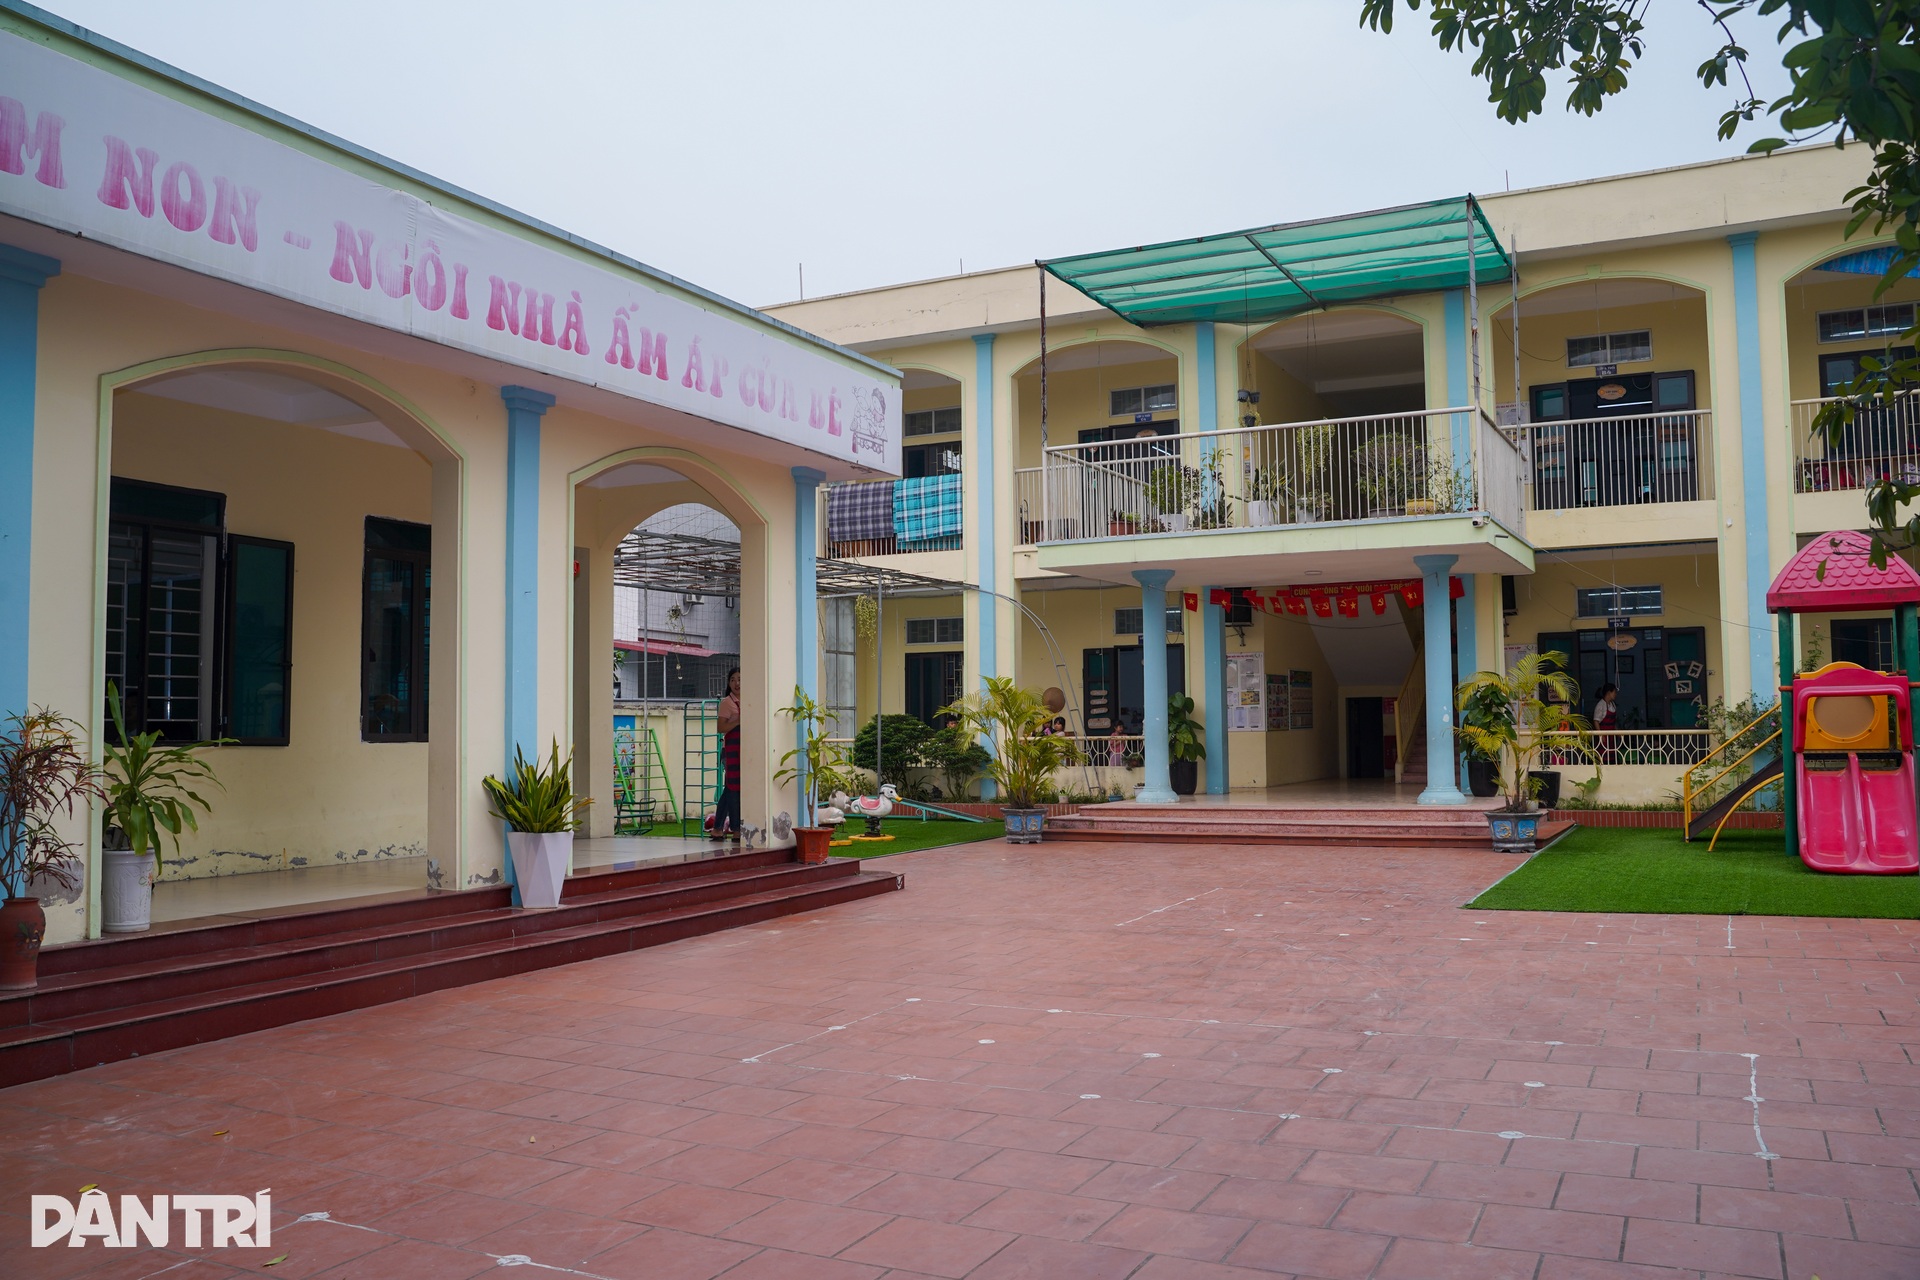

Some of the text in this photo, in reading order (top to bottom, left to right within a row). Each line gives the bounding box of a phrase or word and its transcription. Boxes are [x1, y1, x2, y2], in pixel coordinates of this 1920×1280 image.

[97, 135, 262, 253] NON
[329, 219, 470, 320] NGÔI
[486, 274, 591, 356] NHÀ
[604, 302, 670, 381] ẤM
[738, 354, 800, 423] CỦA
[808, 386, 843, 437] BÉ
